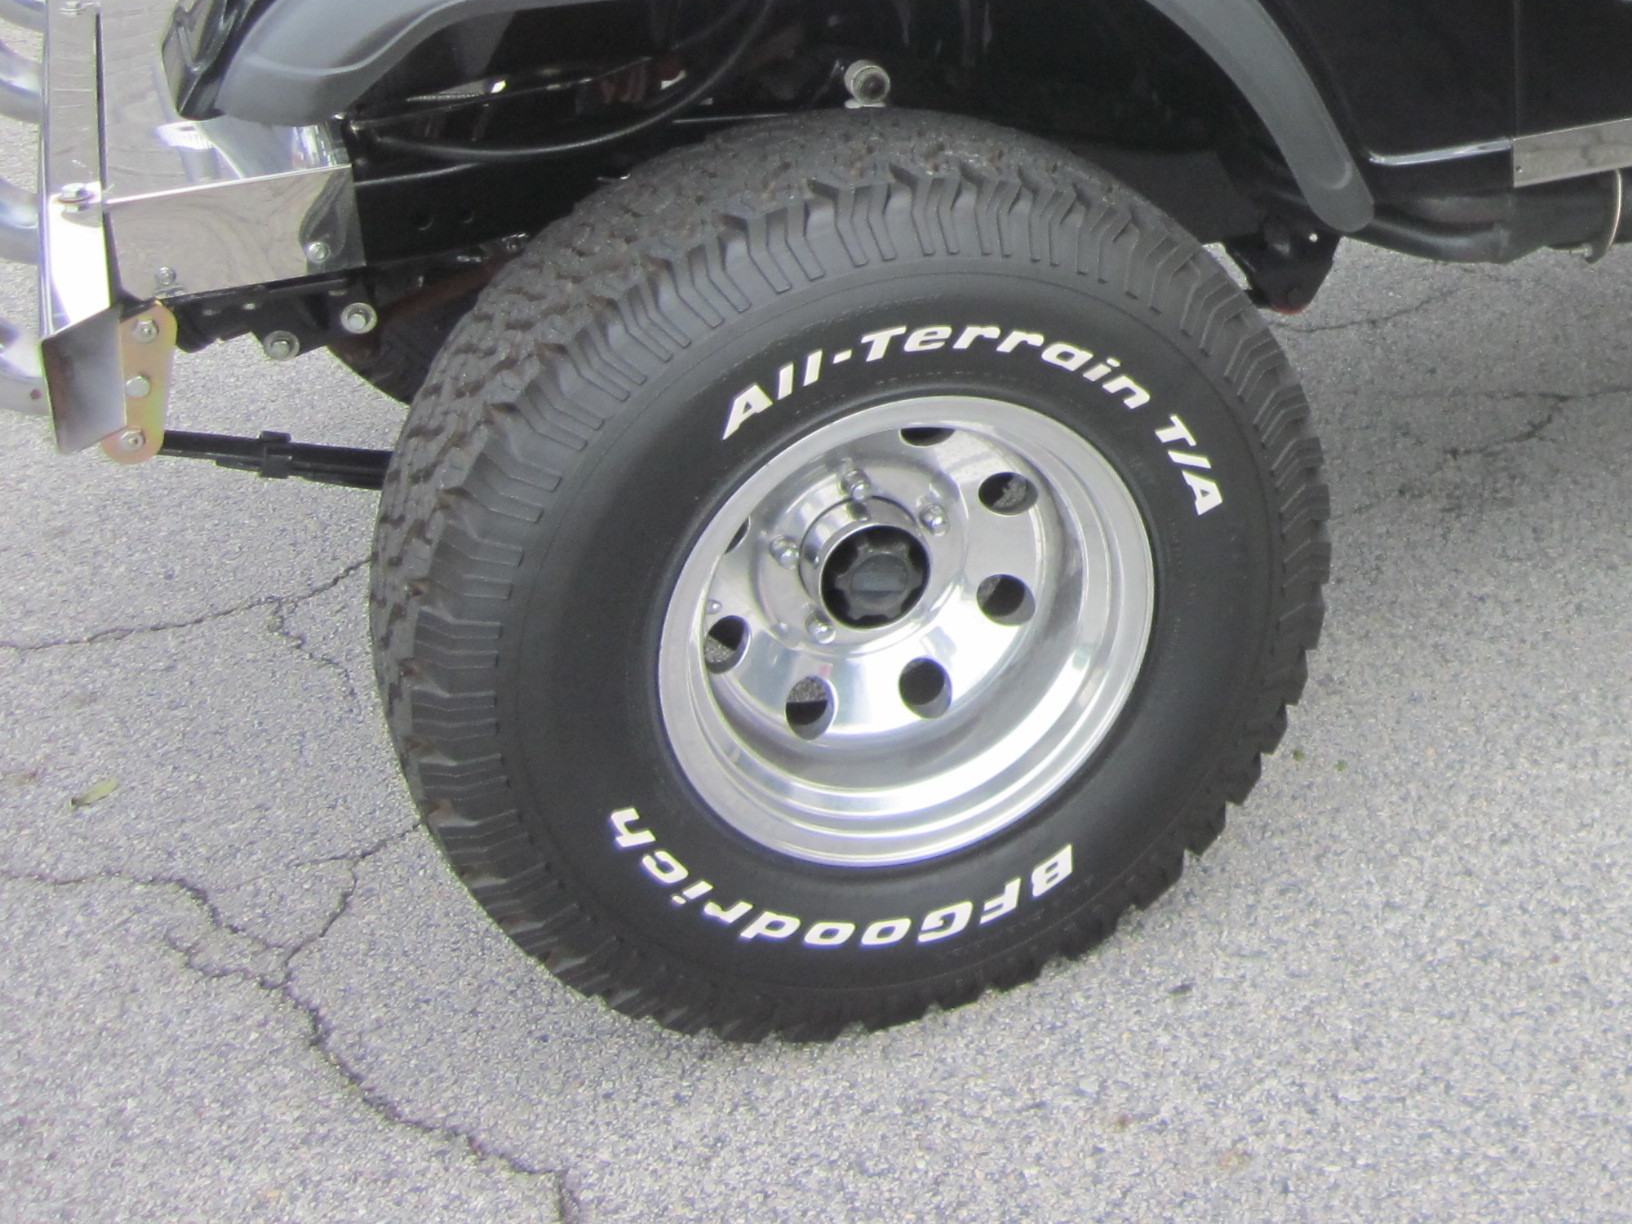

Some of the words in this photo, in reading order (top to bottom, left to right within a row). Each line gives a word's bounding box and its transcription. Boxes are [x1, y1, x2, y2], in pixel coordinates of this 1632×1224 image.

[721, 323, 1153, 442] All-Terrain
[1154, 412, 1225, 517] T/A
[609, 805, 1076, 948] BFGoodrich
